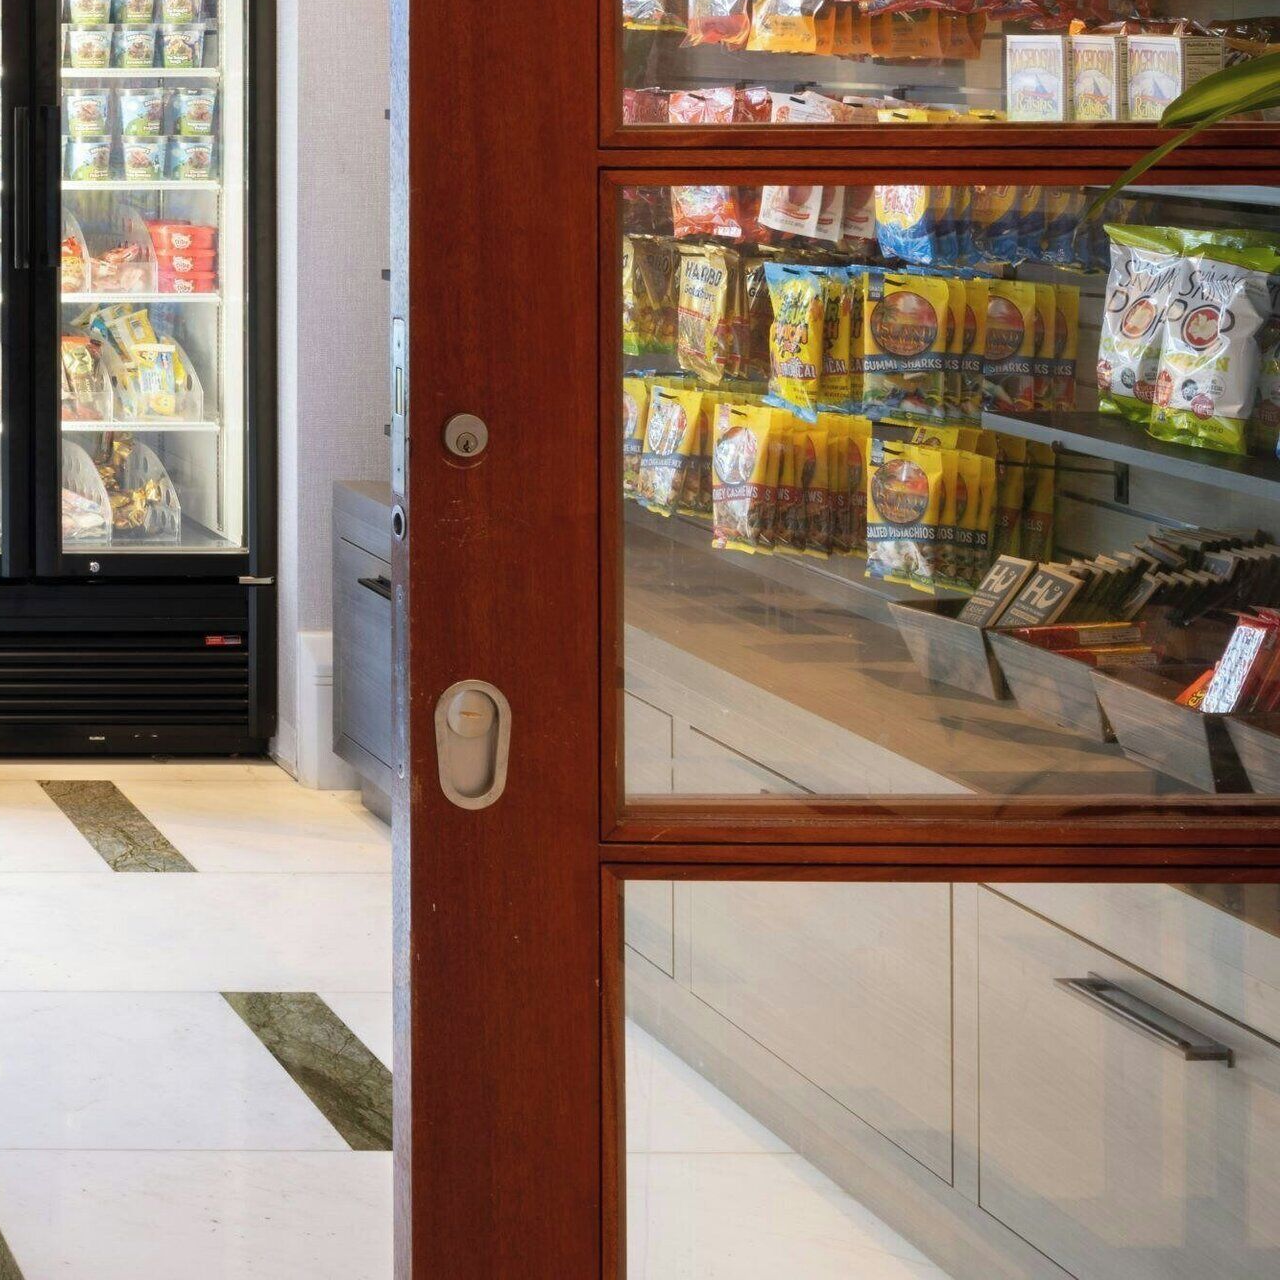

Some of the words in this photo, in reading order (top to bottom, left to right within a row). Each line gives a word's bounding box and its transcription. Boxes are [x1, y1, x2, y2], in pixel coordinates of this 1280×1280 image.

[685, 261, 722, 287] HARIBO
[864, 360, 897, 371] GUMMI
[901, 358, 941, 370] SHARKS
[867, 526, 887, 538] SALTED
[889, 526, 935, 539] PISTACHIOS
